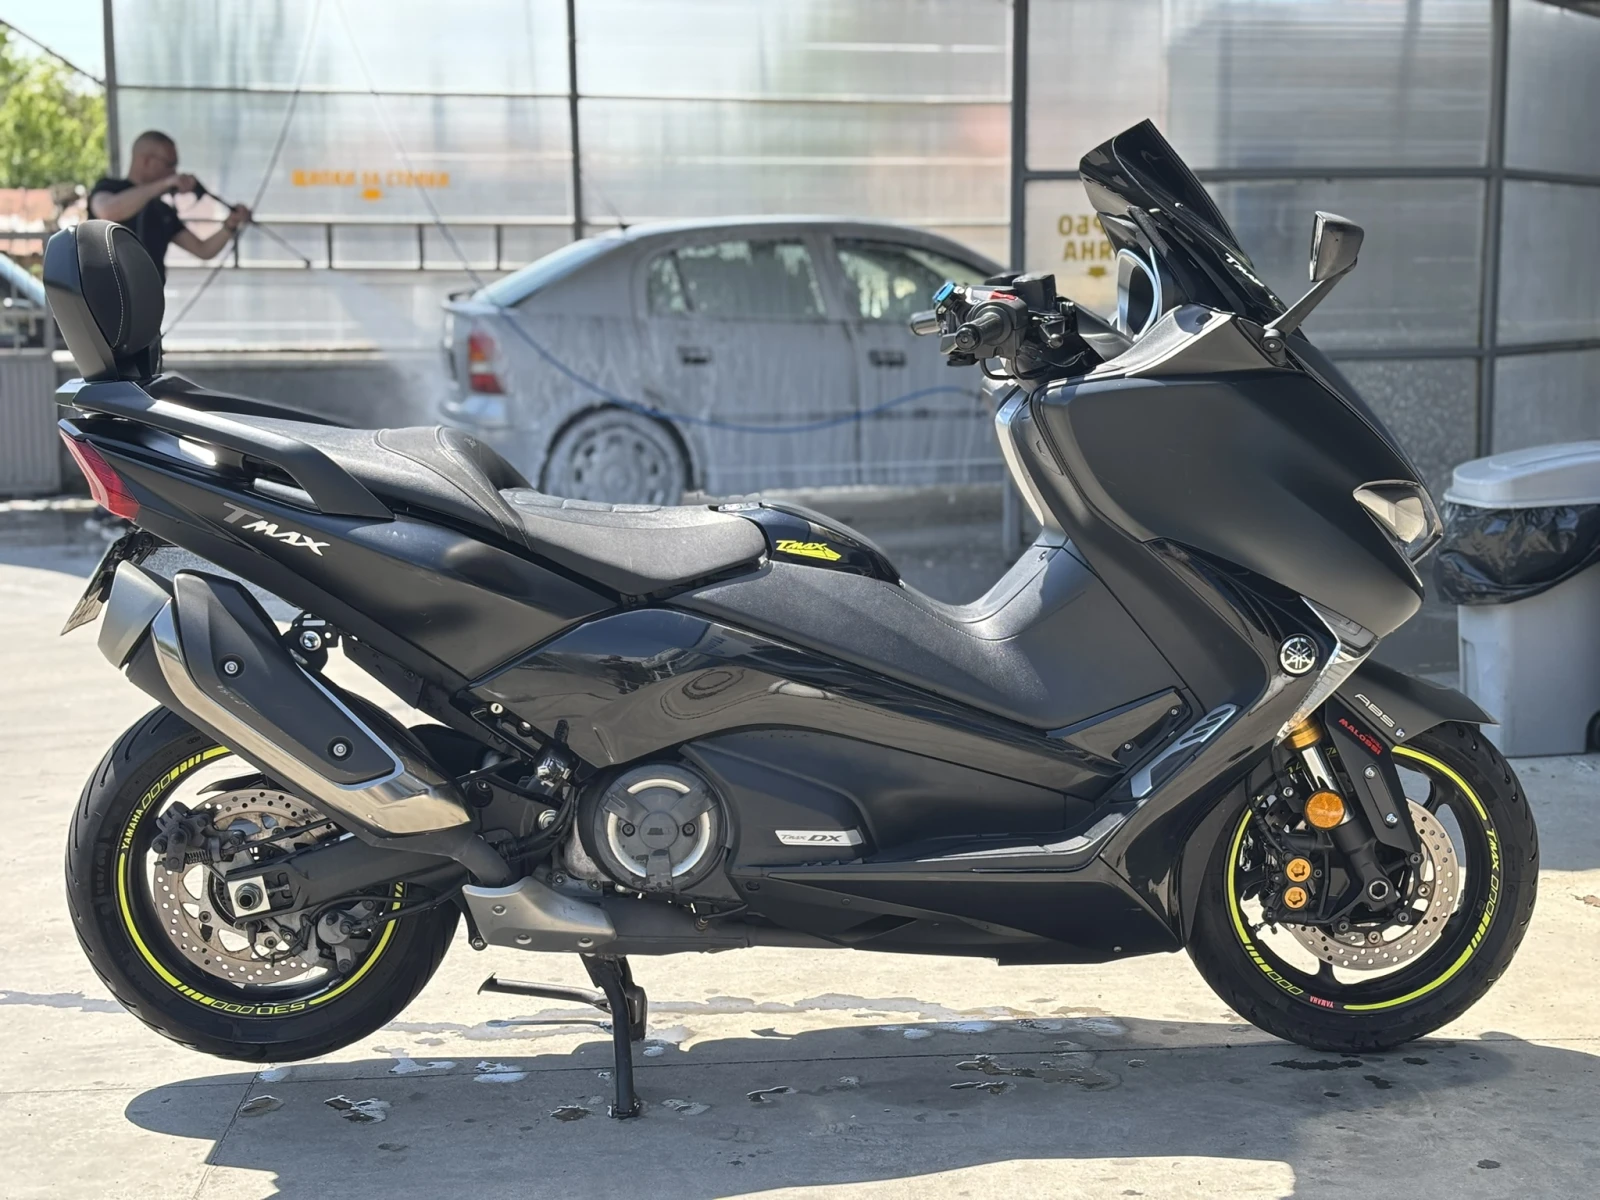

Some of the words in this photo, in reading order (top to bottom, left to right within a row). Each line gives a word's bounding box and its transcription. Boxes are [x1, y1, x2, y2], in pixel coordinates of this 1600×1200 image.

[223, 501, 330, 556] TMAX
[1354, 693, 1395, 728] ABS
[1339, 718, 1382, 755] MALOSSI
[121, 808, 143, 850] YAMAHA
[807, 834, 842, 842] DX
[256, 1000, 306, 1015] 530
